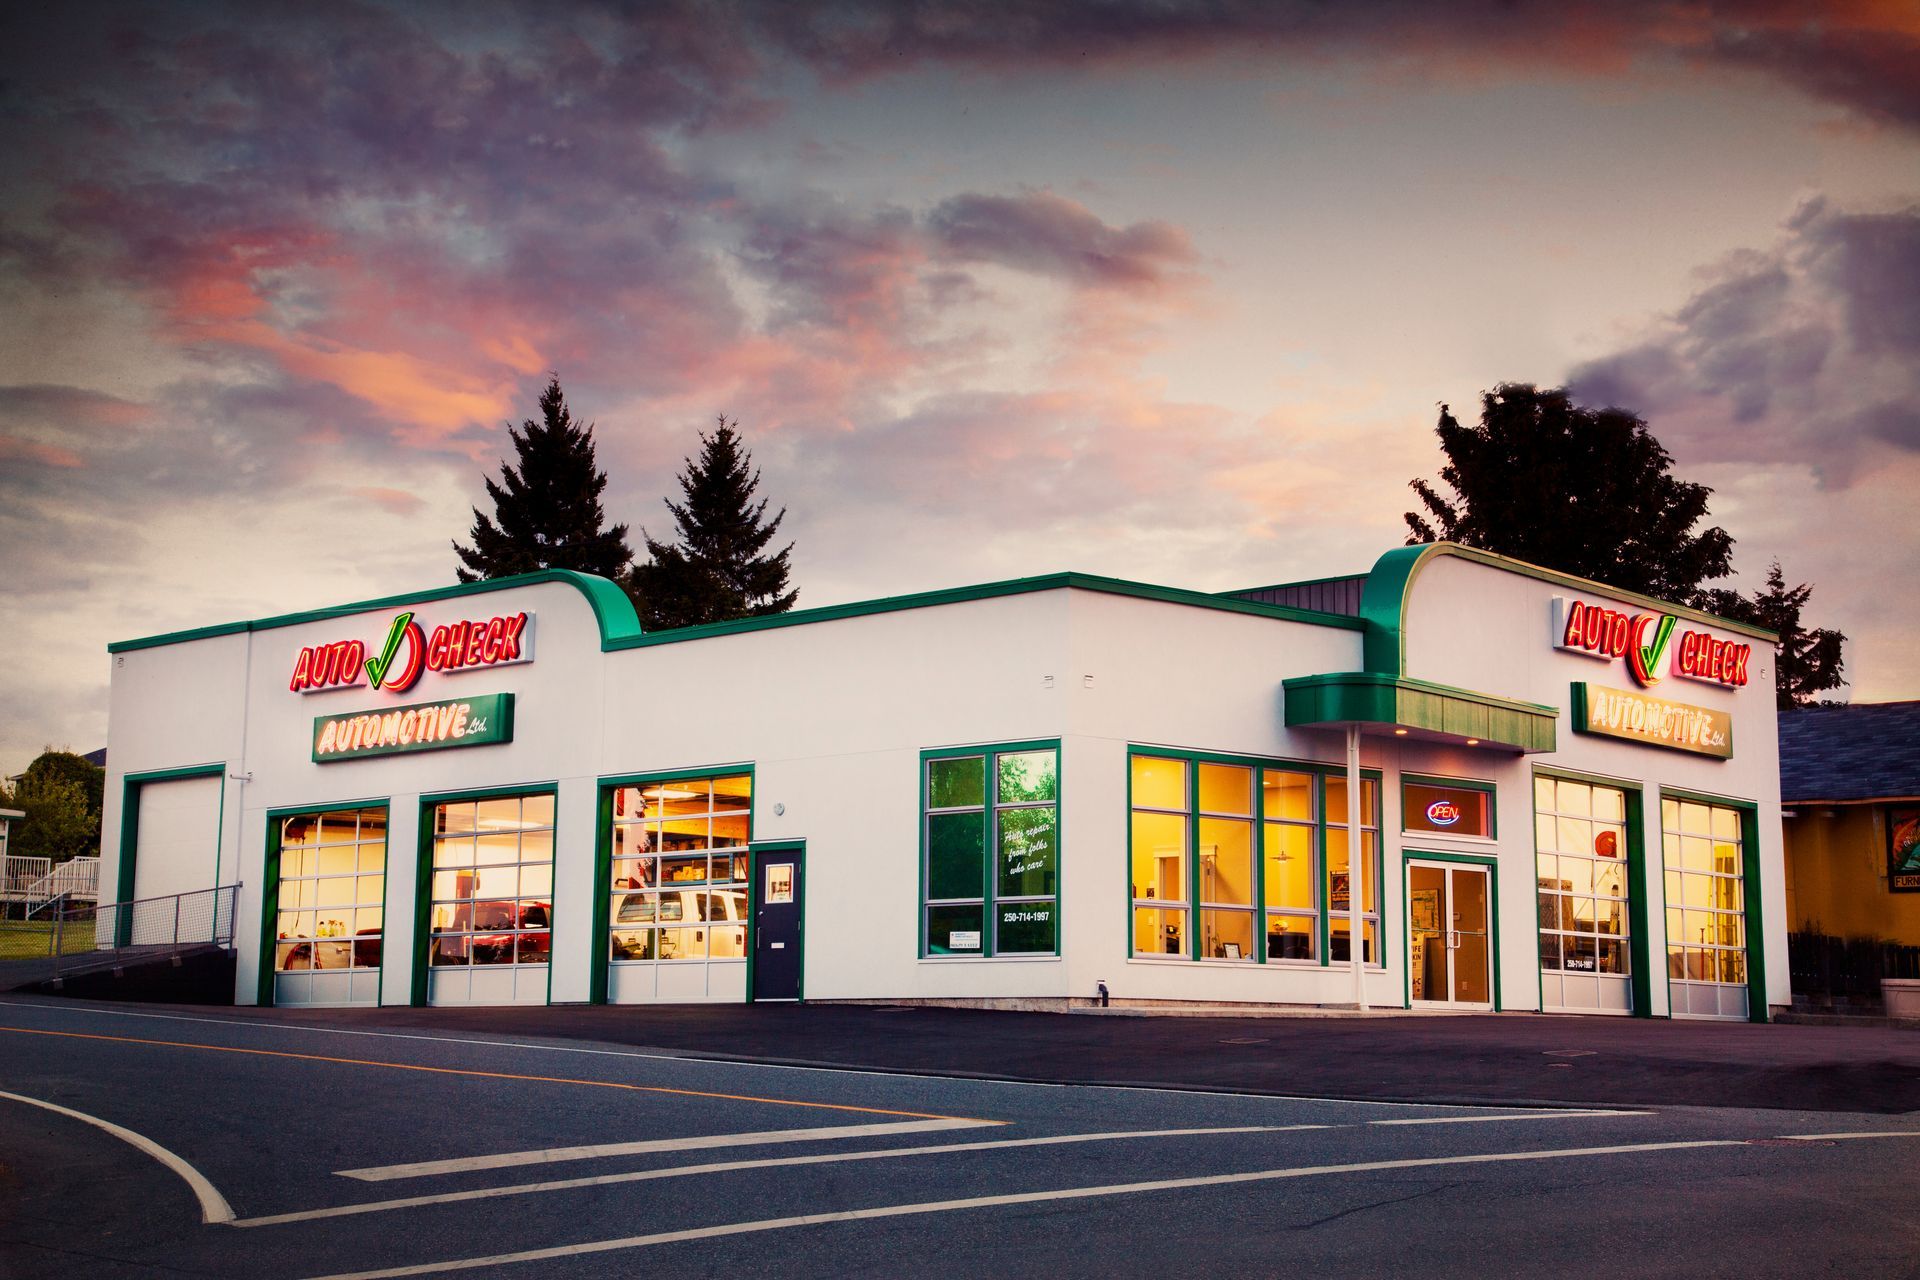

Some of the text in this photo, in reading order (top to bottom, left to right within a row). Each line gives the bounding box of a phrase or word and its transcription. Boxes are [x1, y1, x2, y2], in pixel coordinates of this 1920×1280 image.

[290, 612, 527, 691] AUTO CHECK
[1564, 601, 1750, 686] AUTO CHECK
[318, 703, 470, 755] AUTOMOTIVE
[1592, 692, 1712, 746] AUTOMOTIVE
[1430, 805, 1459, 819] OPEN
[1008, 838, 1048, 862] from folks
[1010, 861, 1025, 874] who
[1004, 911, 1049, 922] 250-714-1997
